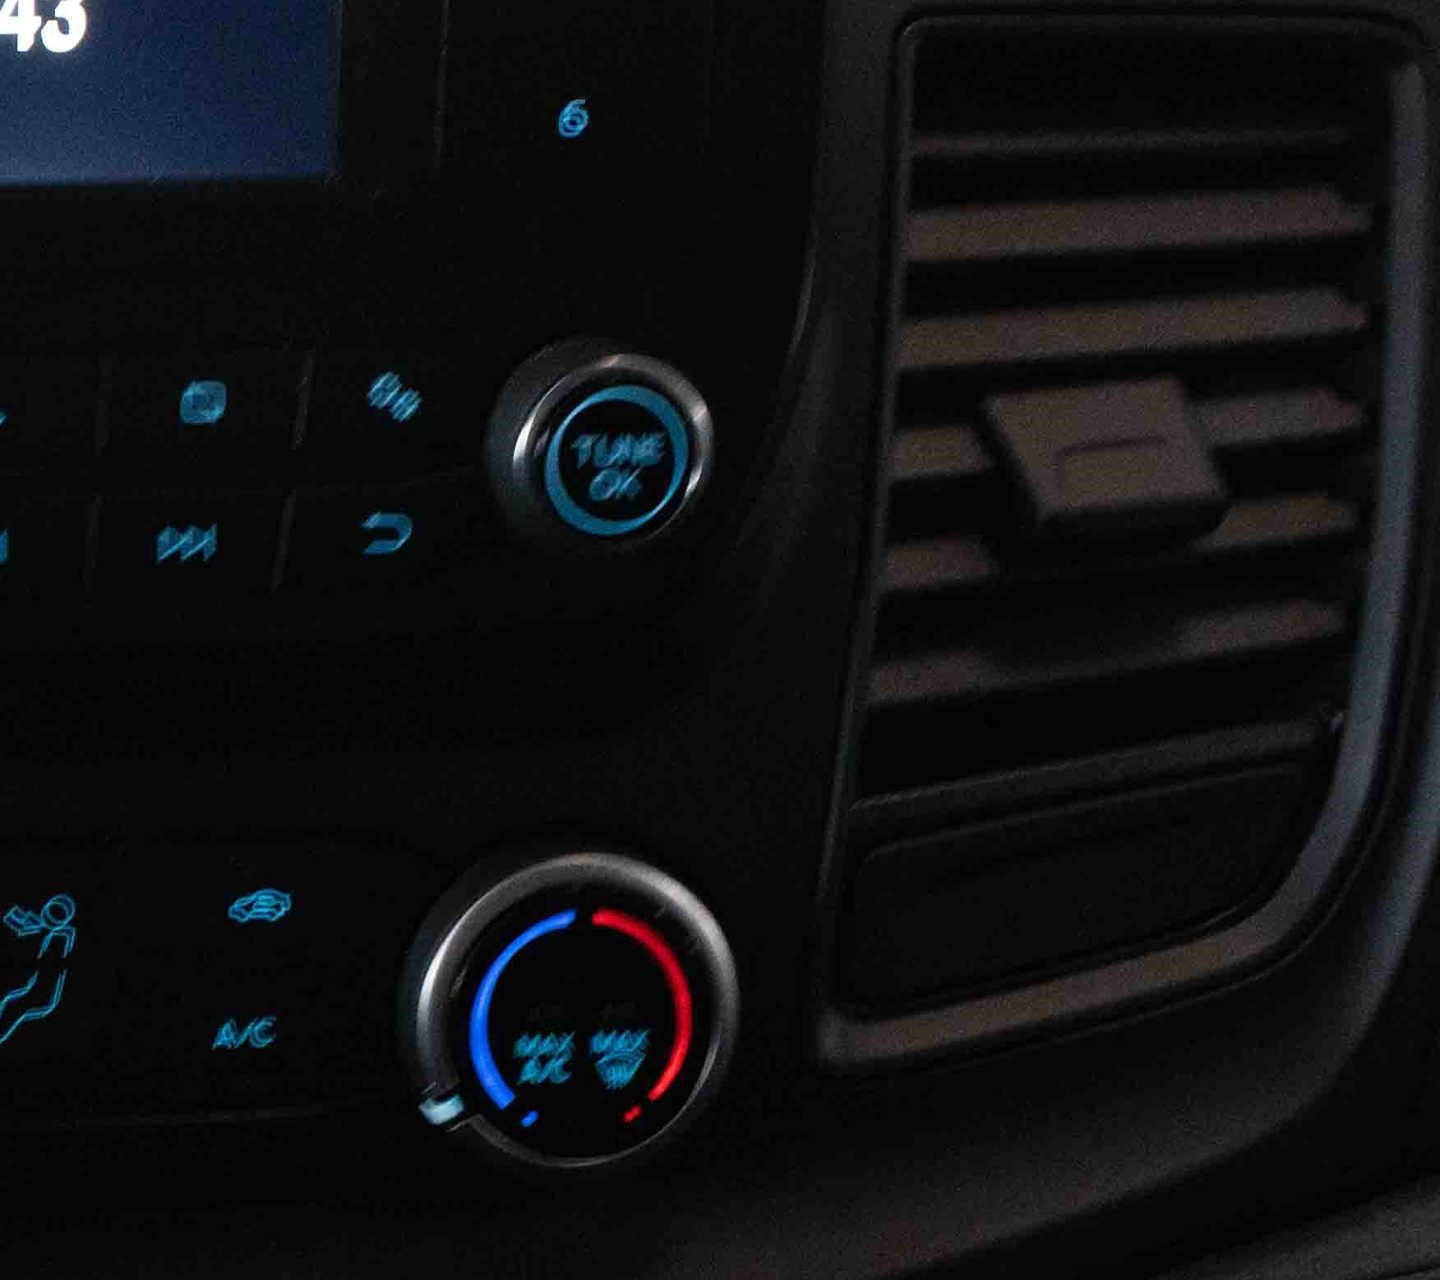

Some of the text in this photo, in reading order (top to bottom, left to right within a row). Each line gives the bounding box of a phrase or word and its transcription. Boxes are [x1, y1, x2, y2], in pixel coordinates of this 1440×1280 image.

[556, 97, 592, 140] 6
[570, 431, 666, 470] TUNE
[588, 466, 644, 503] OK
[211, 1014, 278, 1052] A/C
[513, 1030, 576, 1057] MAX
[588, 1028, 651, 1055] MAX
[515, 1054, 574, 1086] A/C
